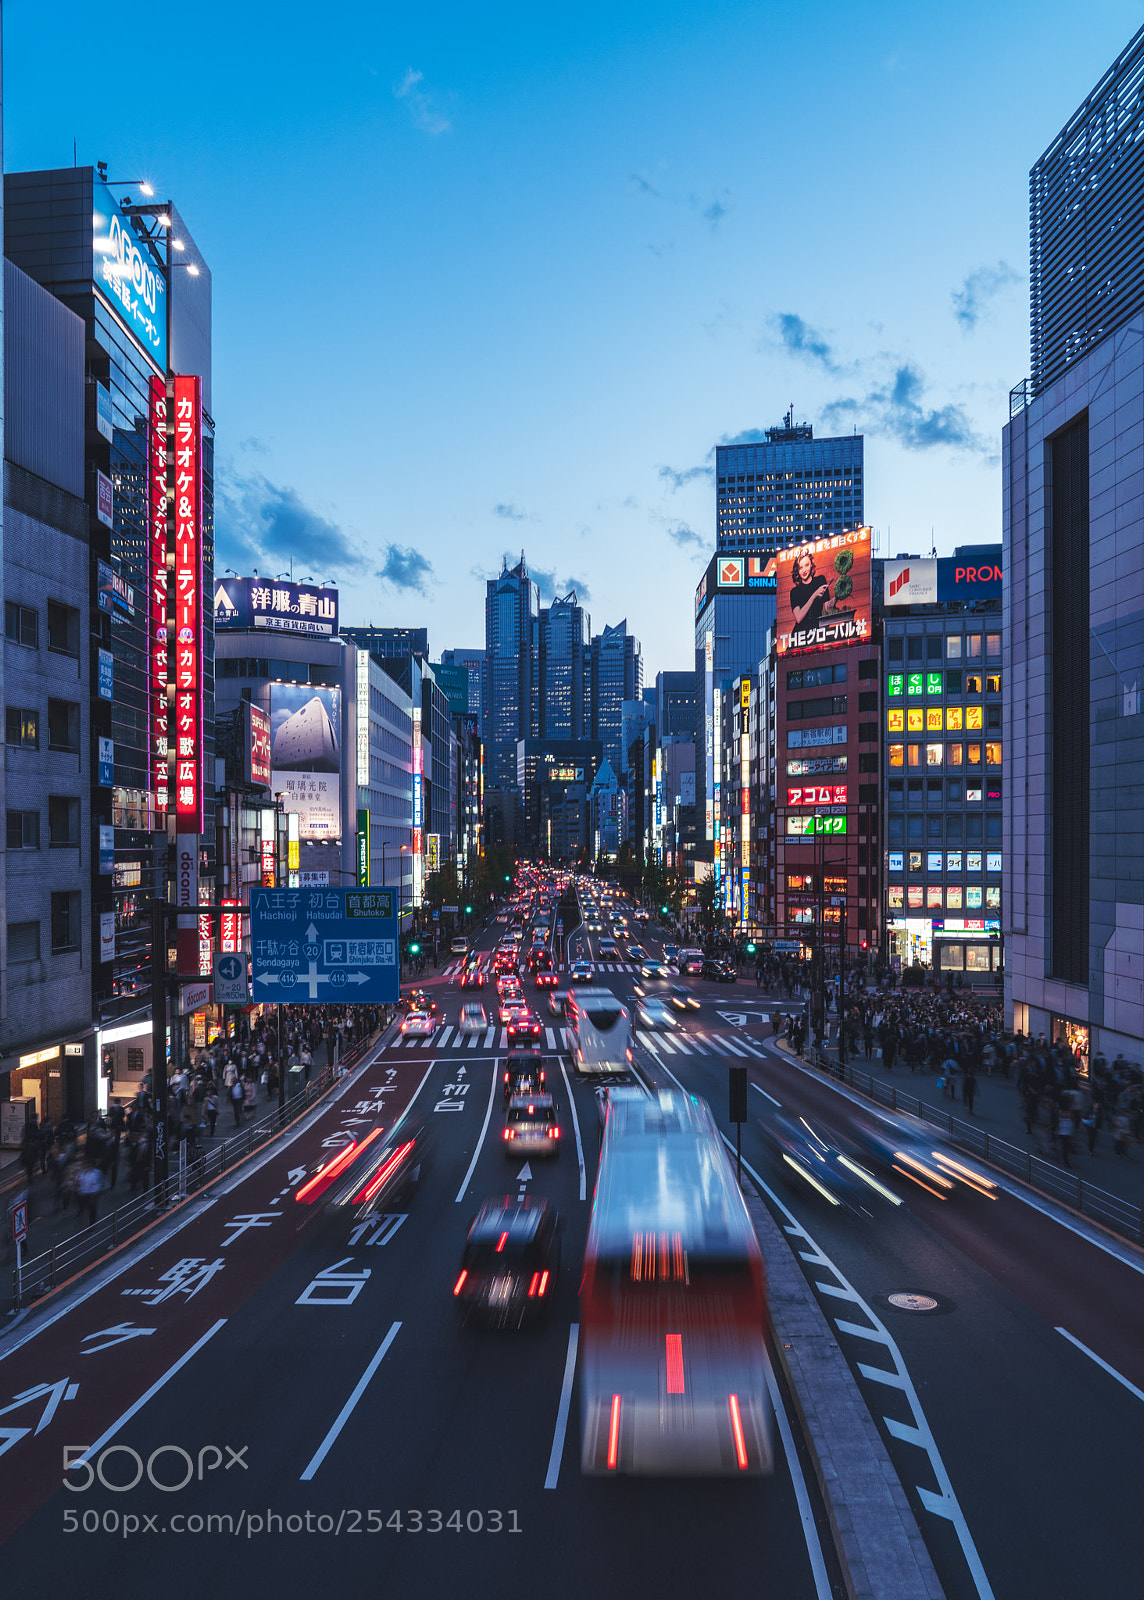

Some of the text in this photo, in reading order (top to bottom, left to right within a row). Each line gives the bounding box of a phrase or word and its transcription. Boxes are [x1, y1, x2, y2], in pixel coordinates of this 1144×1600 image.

[251, 587, 335, 619] 洋服の青山
[265, 617, 324, 632] 京王百貨店向い
[780, 618, 867, 649] THEグローバル社
[891, 672, 939, 686] ほぐし
[890, 712, 941, 729] 占い館
[790, 787, 831, 804] アコム
[815, 817, 843, 831] レイク
[255, 892, 390, 909] 八王子 初台 首都高
[260, 908, 385, 921] Hachioji Hatsudai Shutoko
[348, 941, 394, 956] 新宿駅西口
[256, 958, 300, 968] Sendagaya
[281, 974, 295, 982] 414
[331, 974, 346, 982] 414
[187, 989, 207, 1007] docomo
[434, 1083, 471, 1113] 初台
[295, 1212, 409, 1306] 初台
